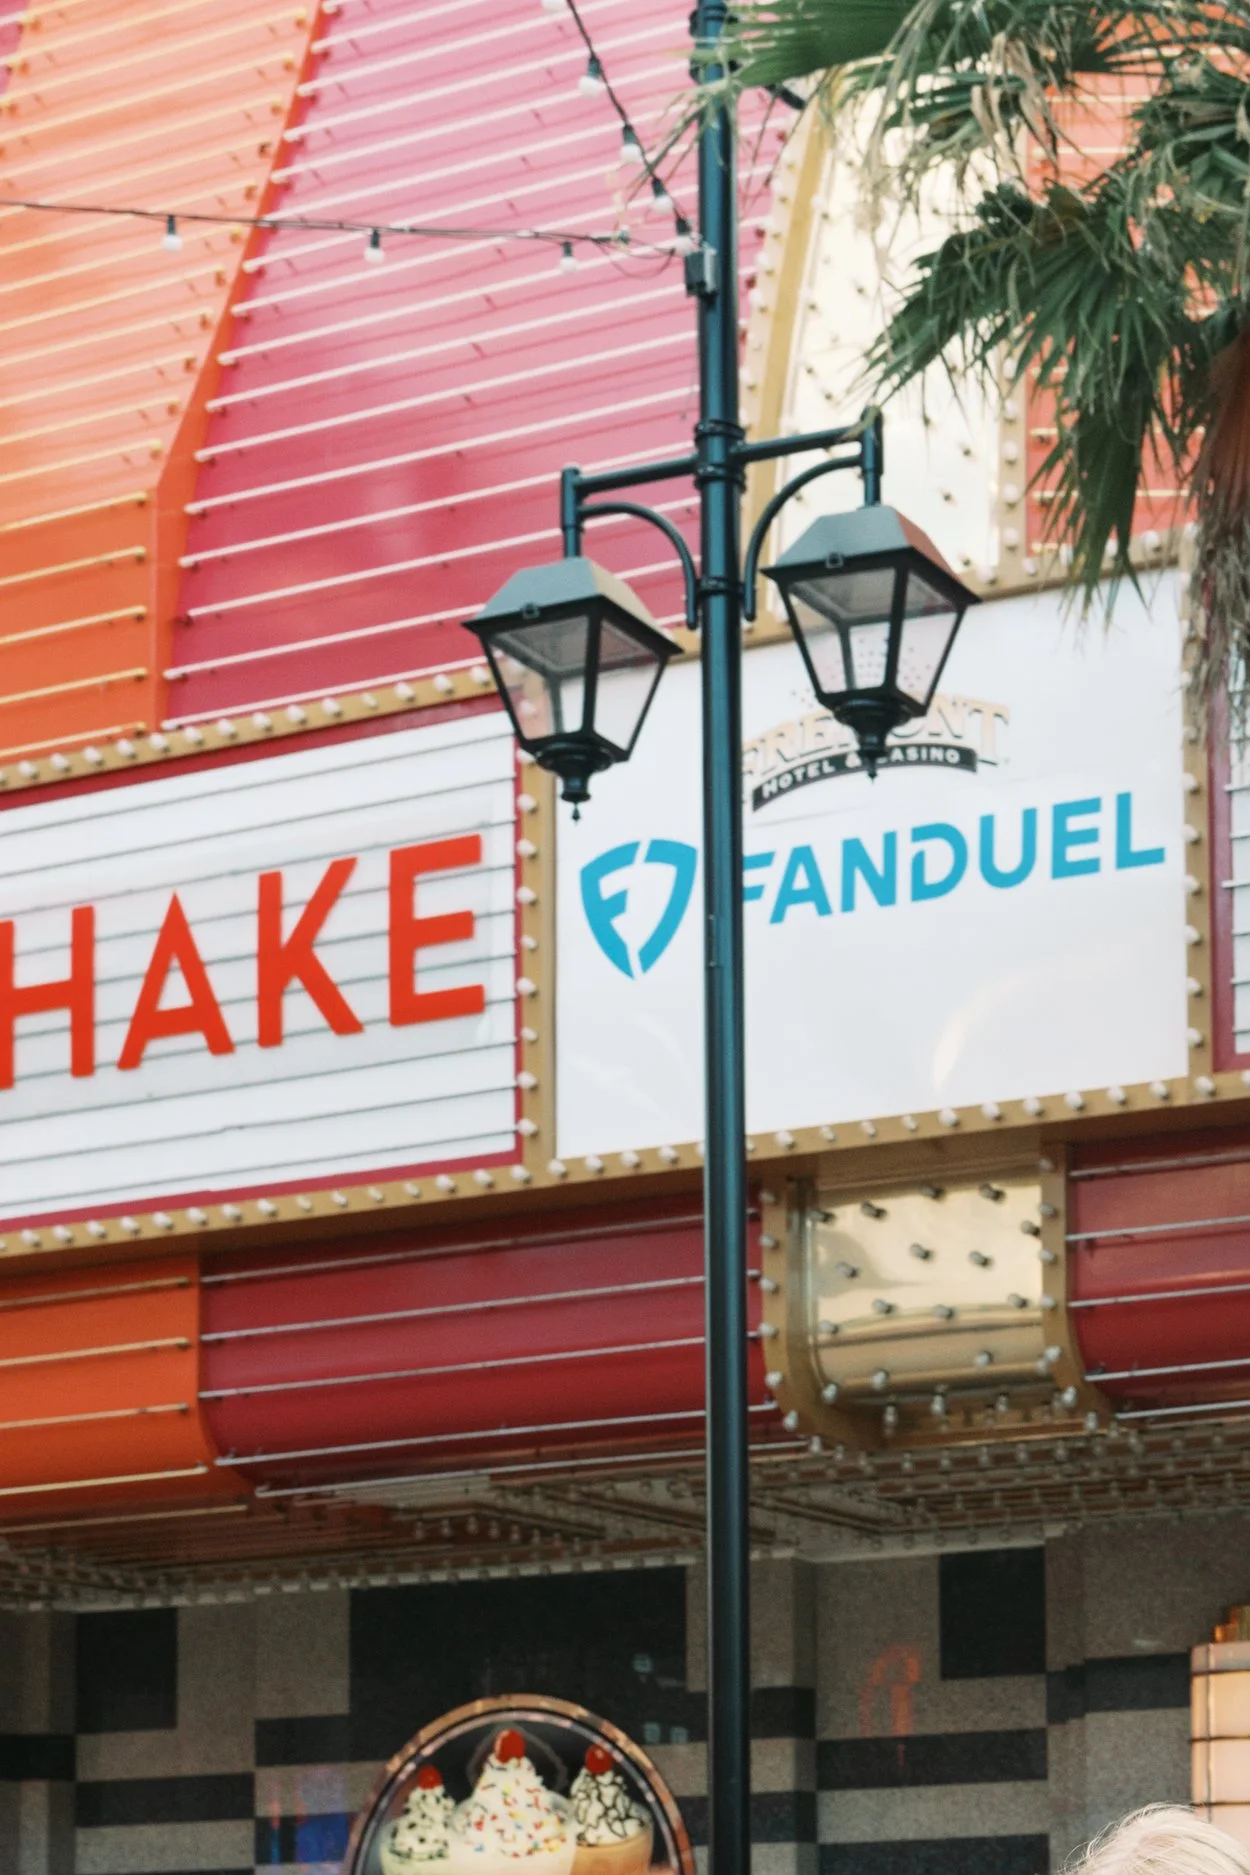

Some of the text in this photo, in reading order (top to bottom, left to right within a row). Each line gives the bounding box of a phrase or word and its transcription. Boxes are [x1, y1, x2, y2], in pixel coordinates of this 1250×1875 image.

[761, 747, 960, 798] HOTEL & ASINO
